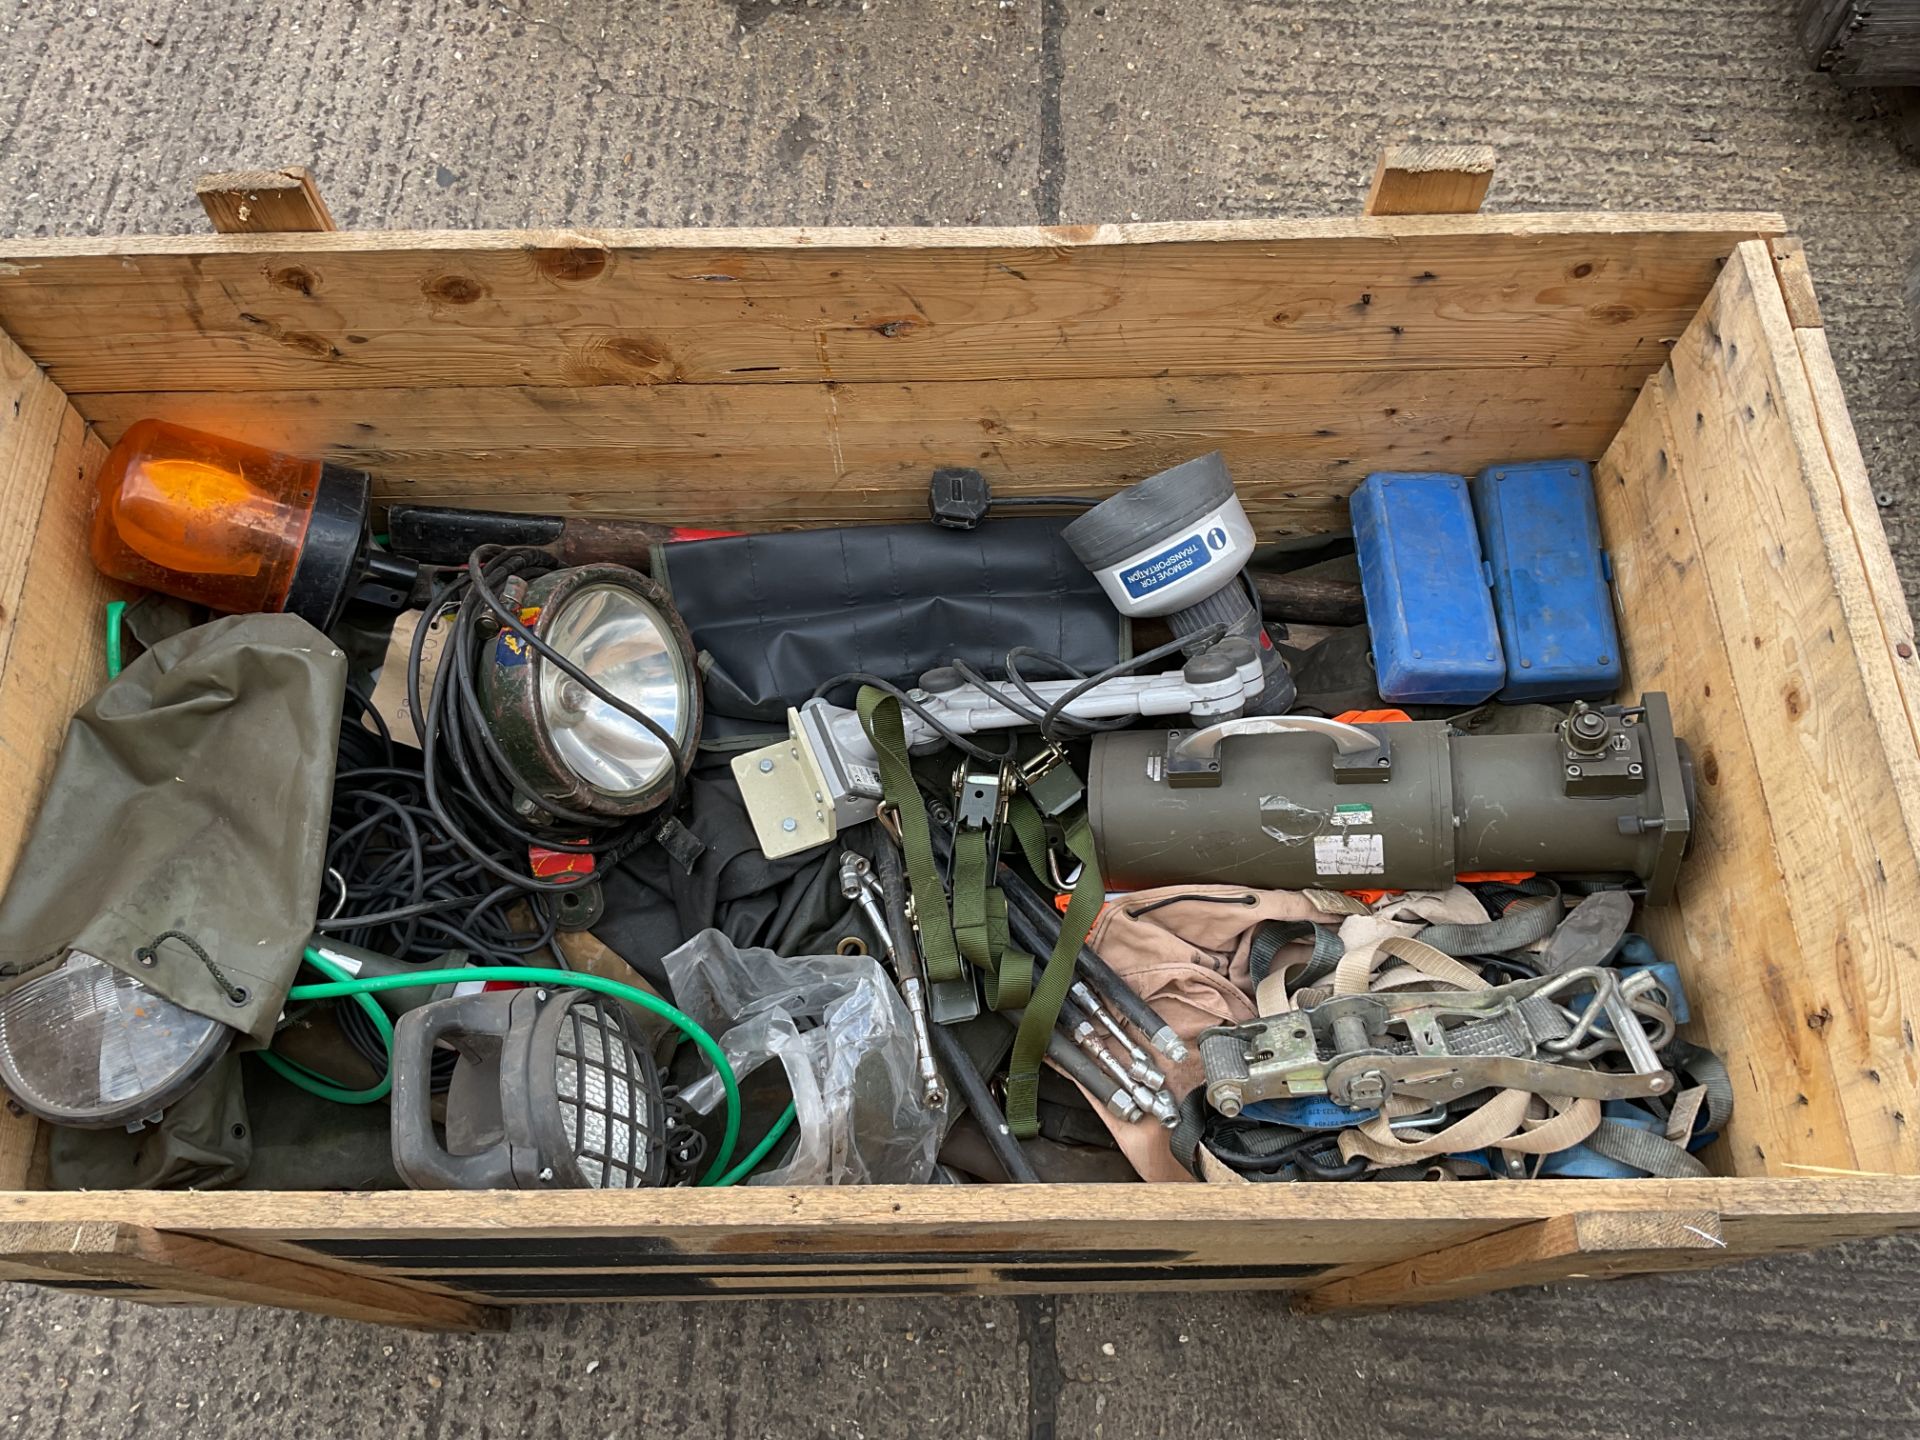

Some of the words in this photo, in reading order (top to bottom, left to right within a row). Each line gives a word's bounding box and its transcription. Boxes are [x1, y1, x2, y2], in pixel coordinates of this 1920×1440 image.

[1127, 544, 1199, 583] TRANSPORTATION
[1159, 558, 1193, 581] REMOVE
[1140, 577, 1158, 588] FOR
